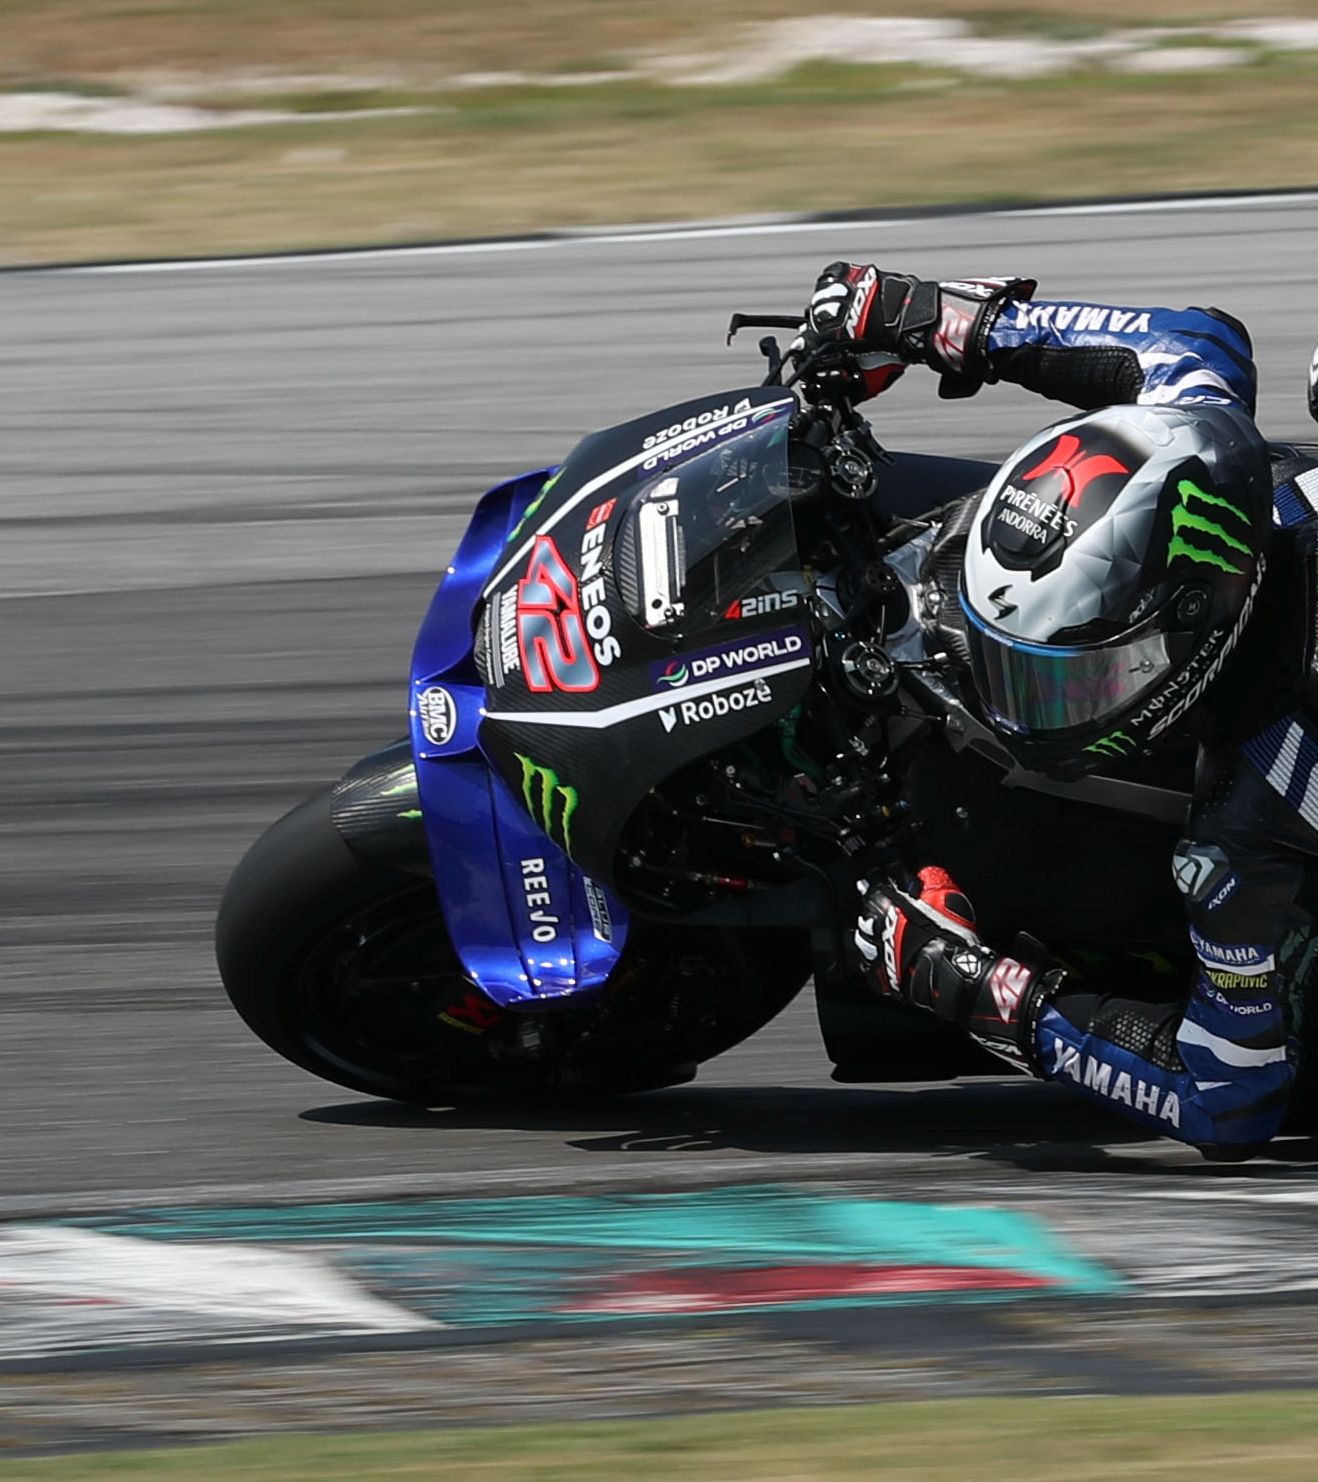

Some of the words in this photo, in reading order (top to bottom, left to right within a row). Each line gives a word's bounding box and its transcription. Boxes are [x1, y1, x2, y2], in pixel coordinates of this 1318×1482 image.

[642, 430, 716, 471] WORLD
[718, 417, 748, 436] DP
[998, 508, 1049, 545] ANDORRA
[517, 534, 601, 694] 42
[579, 523, 622, 667] ENEOS
[499, 584, 521, 675] YAMALUBE
[691, 654, 722, 678] DP
[722, 635, 803, 668] WORLD
[1129, 628, 1225, 728] MONSTER
[427, 691, 450, 739] BMC
[682, 682, 773, 727] Roboze
[1051, 1037, 1181, 1129] YAMAHA
